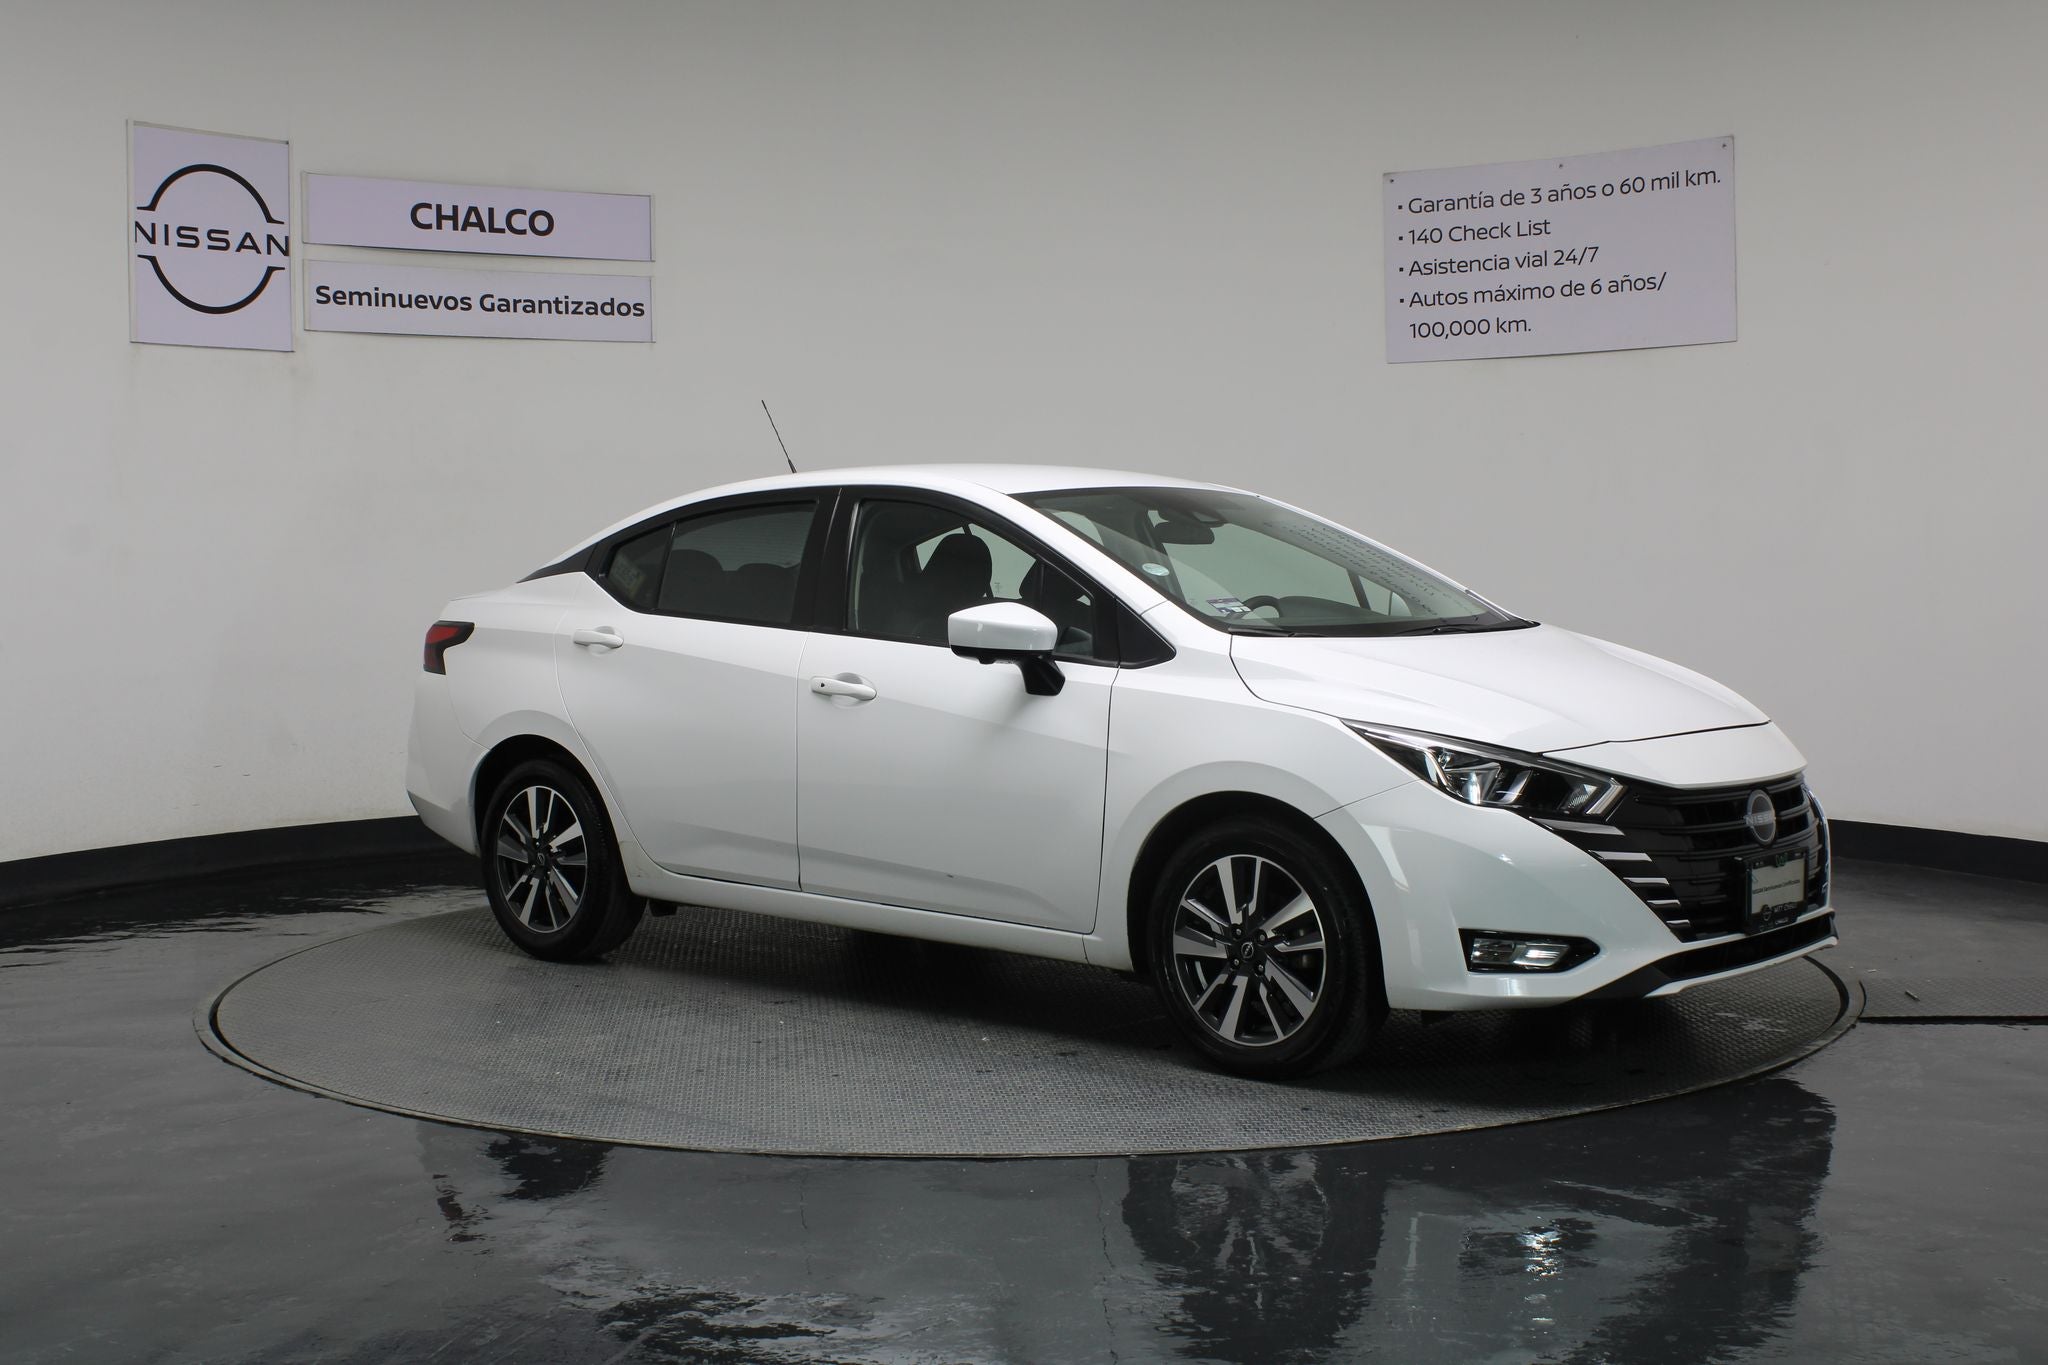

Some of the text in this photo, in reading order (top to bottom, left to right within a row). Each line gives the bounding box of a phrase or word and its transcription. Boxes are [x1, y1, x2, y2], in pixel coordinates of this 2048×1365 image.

[1408, 169, 1721, 214] Garantía de 3 años o 60 mil km.
[409, 202, 555, 237] CHALCO
[1407, 218, 1552, 246] 140 Check List
[135, 221, 289, 257] NISSAN
[1408, 245, 1600, 277] Asistencia vial 24/7
[315, 285, 645, 318] Seminuevos Garantizados
[1408, 271, 1667, 308] Autos máximo de 6 años/
[1409, 316, 1532, 340] 100,000 km.
